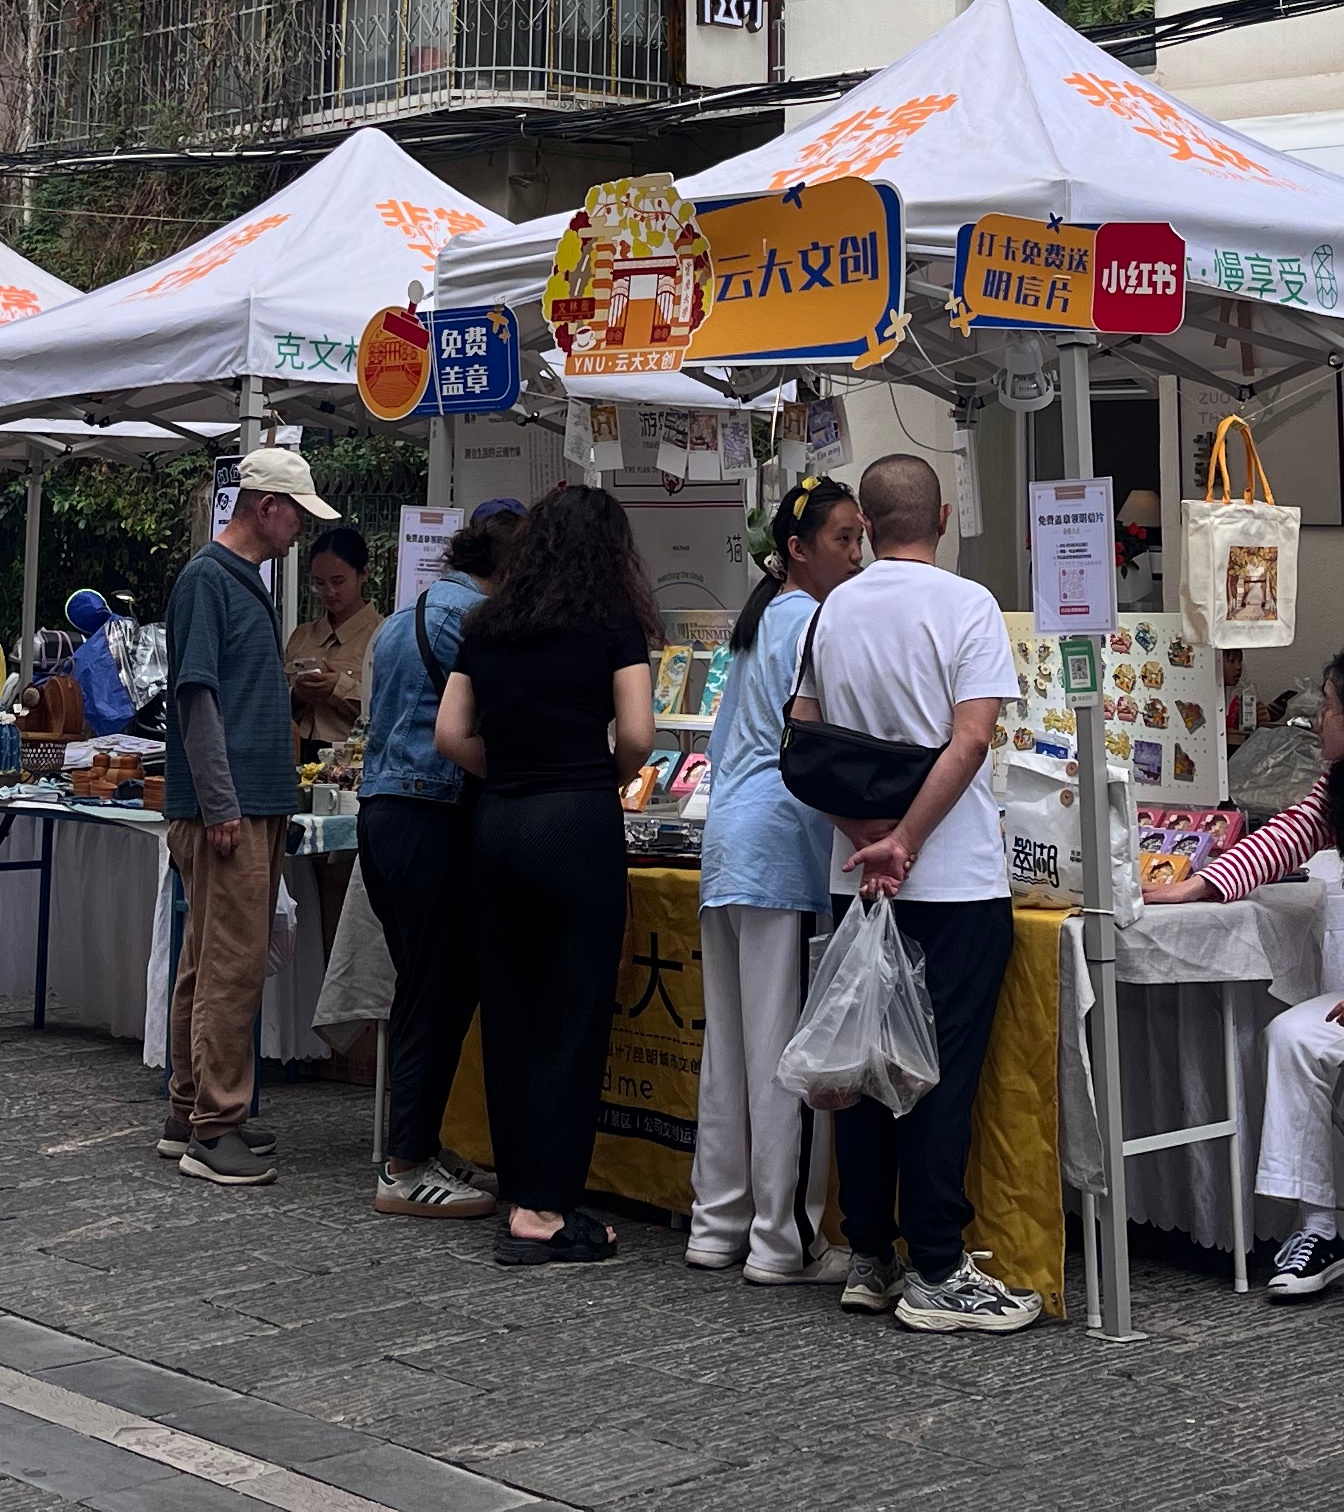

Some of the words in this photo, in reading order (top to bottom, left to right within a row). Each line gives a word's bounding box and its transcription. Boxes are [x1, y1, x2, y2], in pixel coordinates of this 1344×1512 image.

[716, 231, 880, 303] 云大文创
[976, 232, 1090, 274] 打卡免费送
[981, 268, 1074, 314] 明信片
[1102, 261, 1178, 296] 小红书
[1186, 248, 1309, 306] ·慢享受
[441, 326, 488, 359] 免费
[574, 351, 676, 374] YNU·云大文创
[441, 364, 489, 397] 盖章
[726, 534, 743, 563] 猫
[618, 1075, 654, 1101] me
